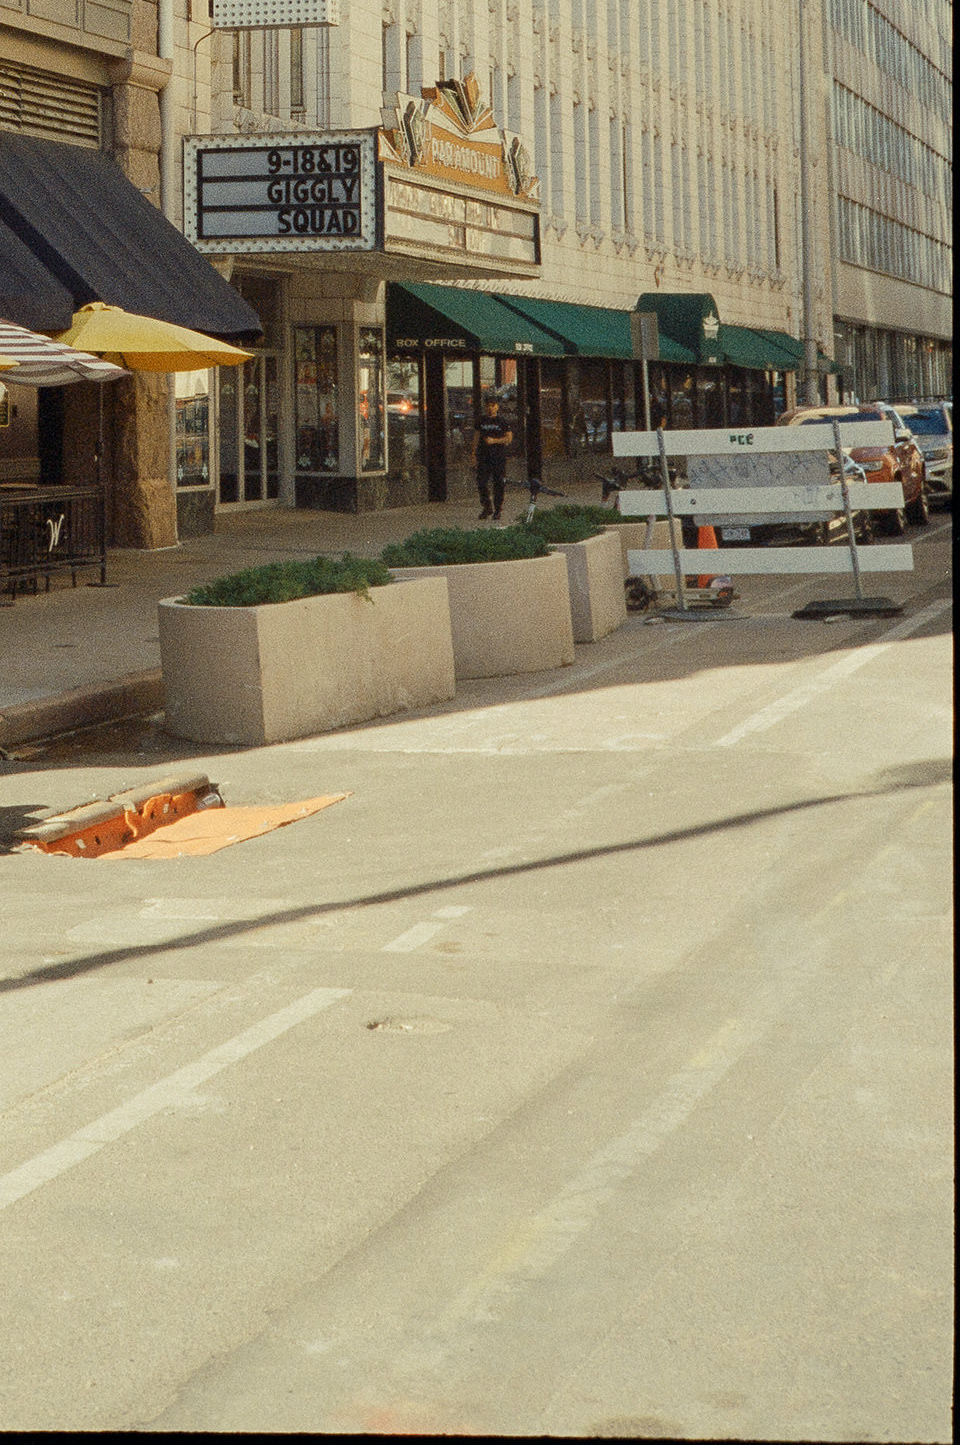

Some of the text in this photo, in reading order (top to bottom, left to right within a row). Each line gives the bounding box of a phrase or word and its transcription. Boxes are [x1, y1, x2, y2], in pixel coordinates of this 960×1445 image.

[267, 148, 357, 174] 9-18&19
[267, 178, 357, 204] GIGGLY
[278, 209, 357, 234] SQUAD
[396, 339, 466, 347] BOX OFFICE
[46, 513, 64, 552] W
